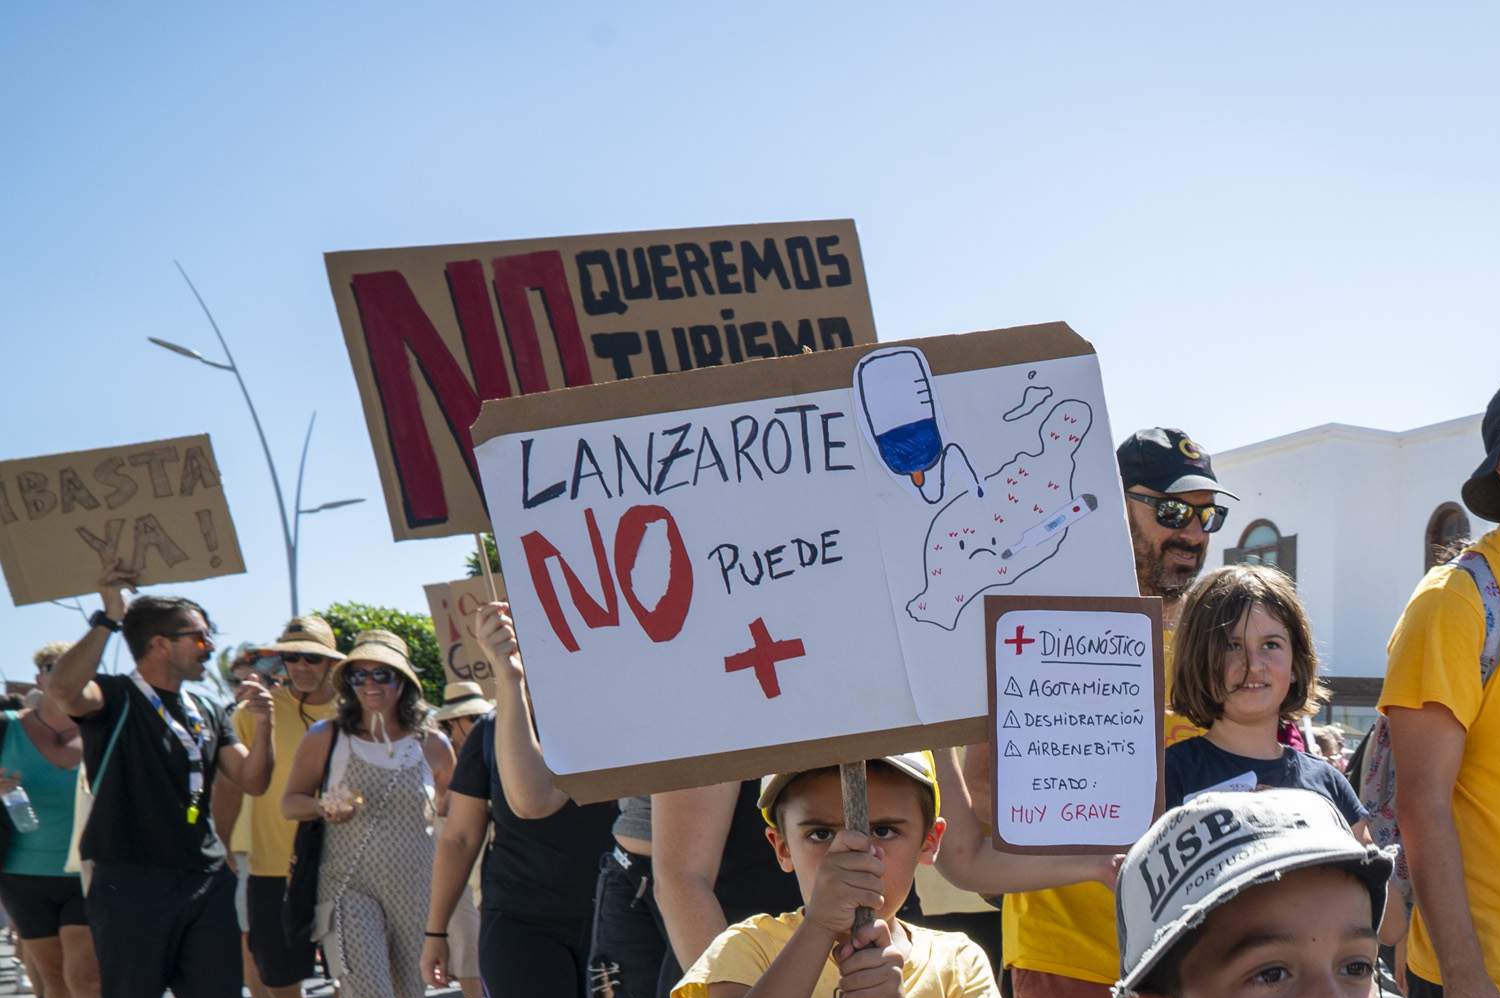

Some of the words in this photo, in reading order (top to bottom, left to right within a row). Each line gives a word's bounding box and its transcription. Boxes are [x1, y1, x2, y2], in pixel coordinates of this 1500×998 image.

[576, 234, 852, 316] QUEREMOS
[351, 250, 592, 528] NO
[521, 404, 856, 509] LANZAROTE
[75, 508, 223, 574] YA!
[707, 529, 843, 595] PUEDE
[520, 504, 694, 653] NO
[1039, 628, 1146, 658] DIAGNÓSTICO
[1028, 678, 1140, 697] AGOTAMIENTO
[1027, 741, 1136, 756] AIRBENEBITIS
[1061, 803, 1121, 822] GRAVE
